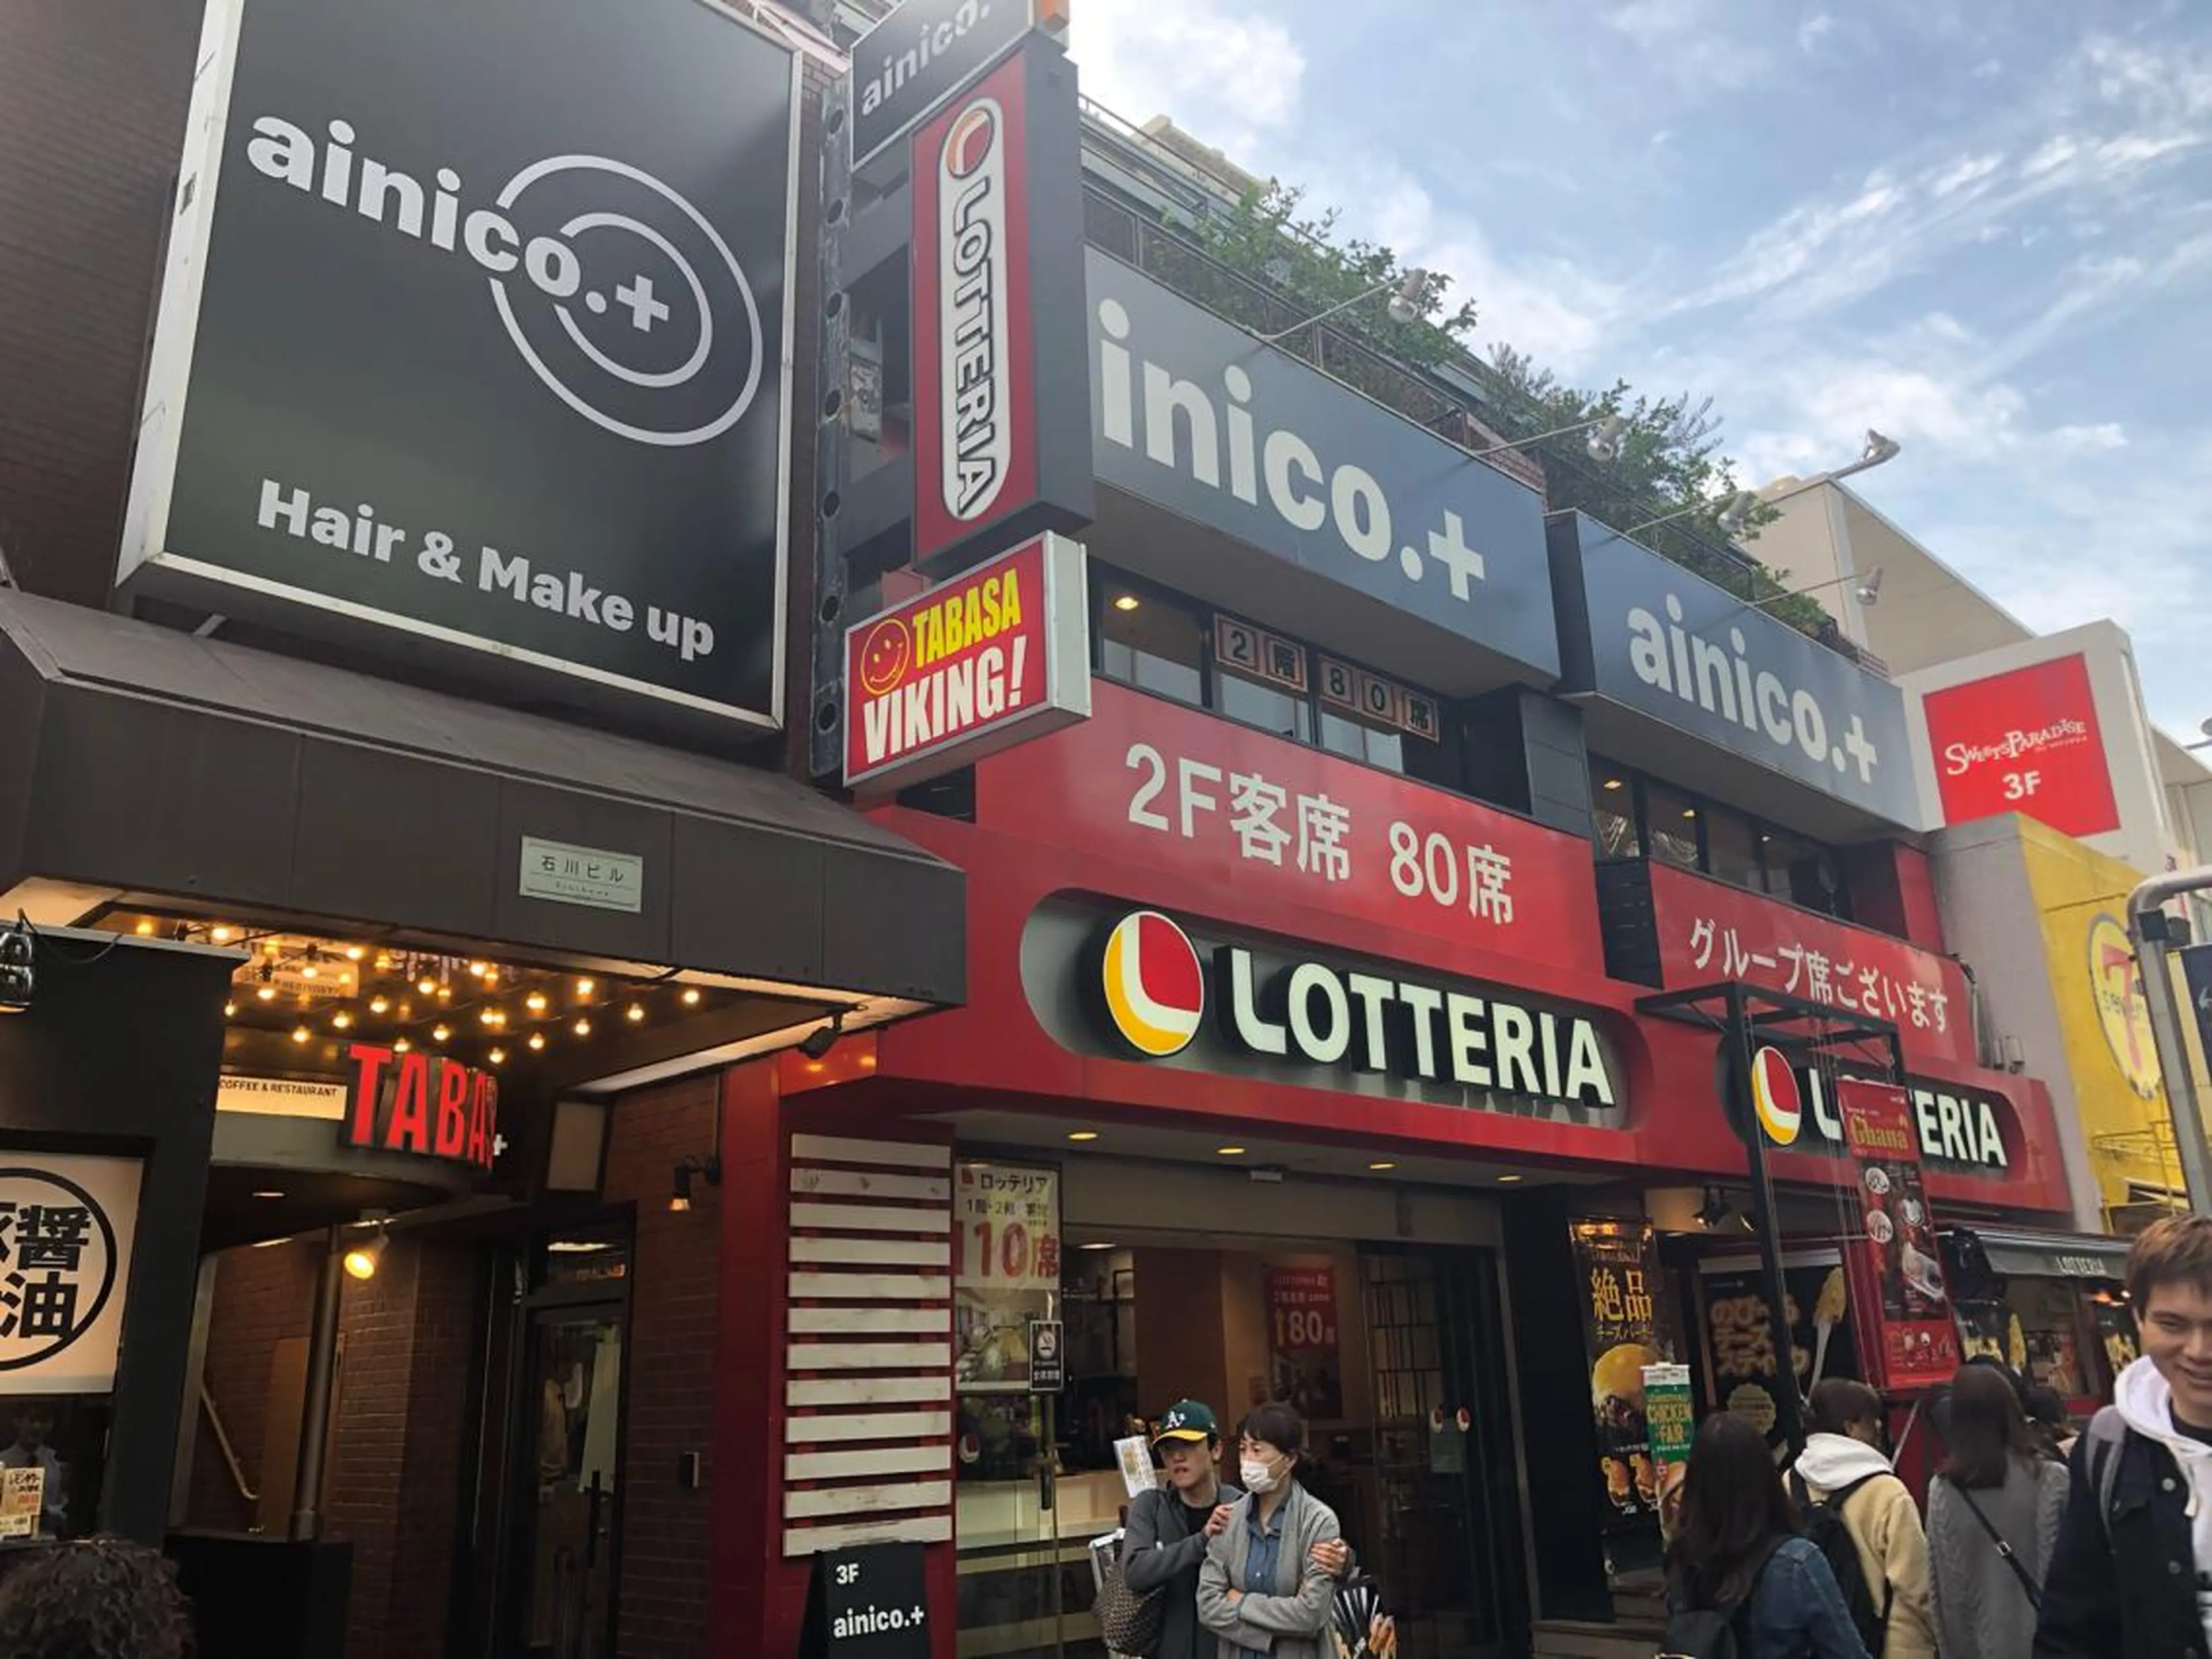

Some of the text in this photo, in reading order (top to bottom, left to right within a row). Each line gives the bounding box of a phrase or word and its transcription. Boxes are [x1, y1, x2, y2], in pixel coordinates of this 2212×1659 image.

[247, 116, 670, 332] ainico.+
[953, 176, 997, 516] LOTTERIA
[1099, 298, 1486, 603] inico.+
[257, 479, 715, 662] Hair & Make up
[912, 567, 1021, 669] TABASA
[863, 635, 1028, 764] VIKING!
[1626, 593, 1878, 785] ainico.+
[1125, 743, 1514, 925] 2F客席 80席
[2002, 770, 2041, 800] 3F
[1227, 946, 1616, 1107] LOTTERIA
[1590, 1267, 1652, 1322] 絶品
[834, 1604, 924, 1638] ainico.+
[836, 1563, 859, 1584] 3F
